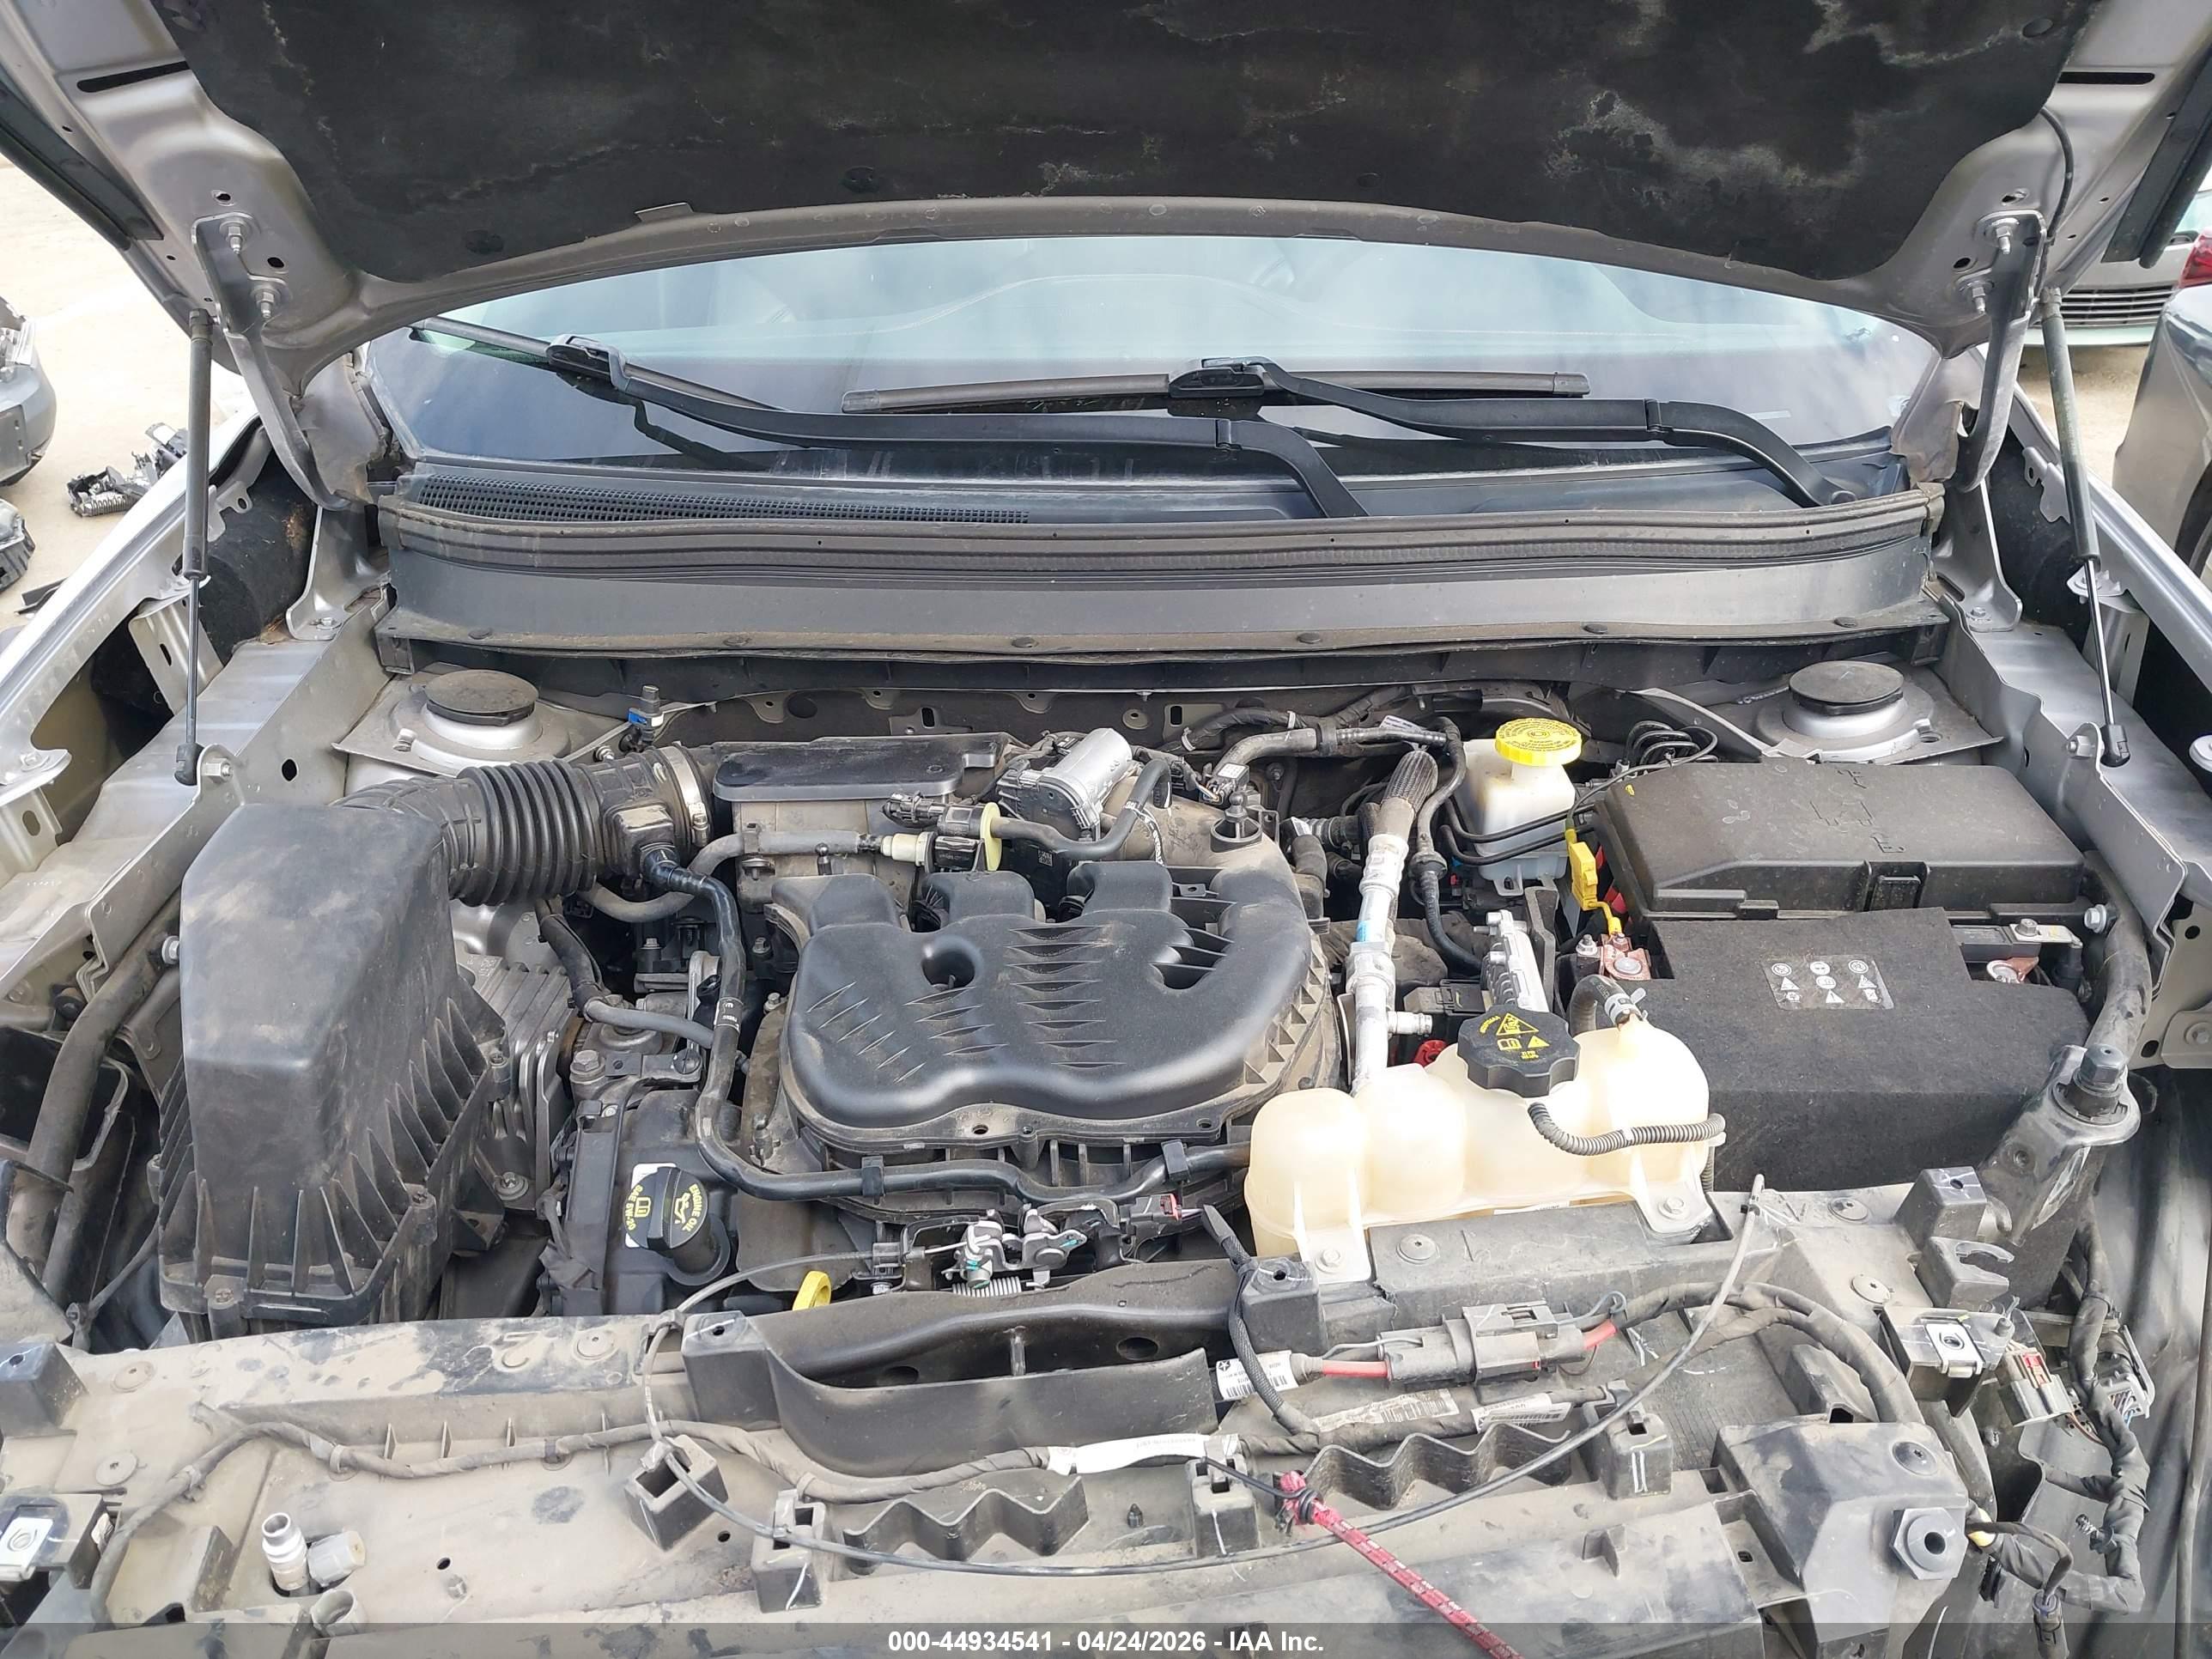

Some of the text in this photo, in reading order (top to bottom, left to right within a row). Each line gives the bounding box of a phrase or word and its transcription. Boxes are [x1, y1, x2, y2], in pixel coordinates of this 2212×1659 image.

[625, 1185, 643, 1231] SAE 5W-20
[683, 1184, 702, 1231] ENGINE OIL
